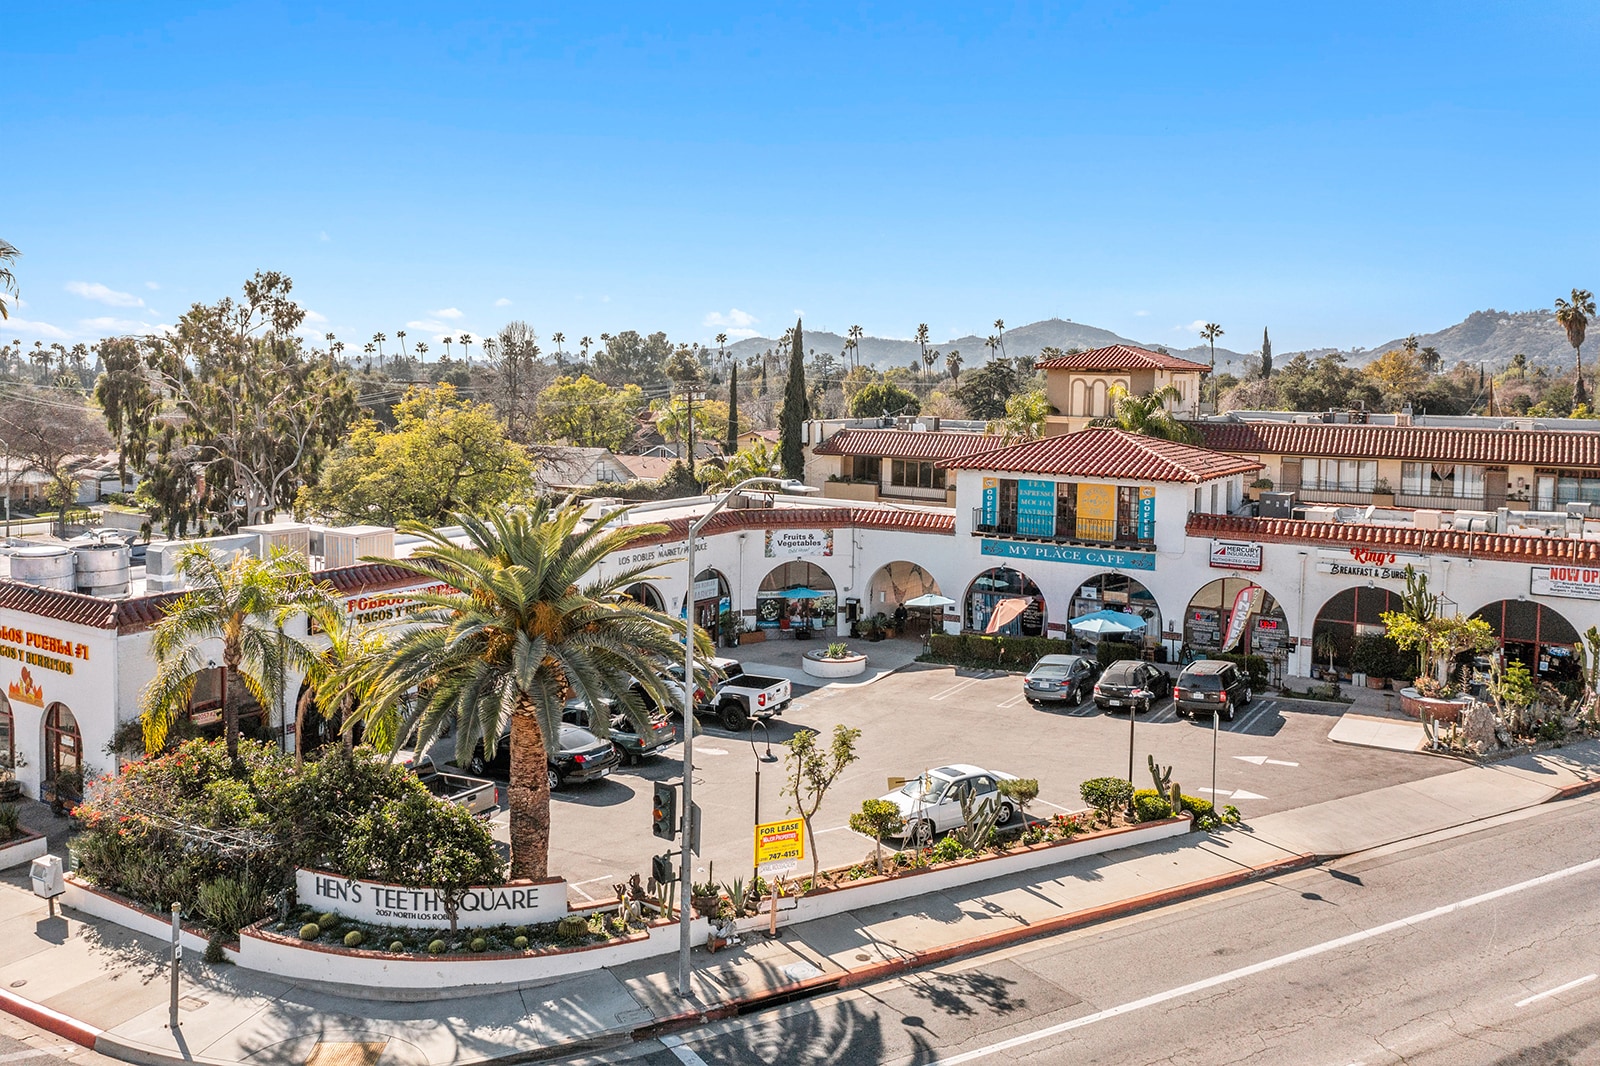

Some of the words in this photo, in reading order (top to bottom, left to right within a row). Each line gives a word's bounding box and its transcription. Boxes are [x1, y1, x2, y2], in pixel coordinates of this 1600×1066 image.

[1028, 480, 1046, 488] TEA
[1021, 499, 1052, 507] MOCHA
[618, 556, 631, 566] LOS
[632, 551, 655, 563] ROBLES
[1009, 545, 1032, 556] MY
[1086, 553, 1125, 565] CAFE
[1349, 547, 1397, 566] King's
[1374, 568, 1380, 577] &
[1380, 567, 1417, 580] BURGES
[1550, 567, 1580, 582] NOW
[1582, 569, 1600, 584] OP
[356, 607, 393, 626] TACOS
[395, 606, 404, 618] Y
[0, 625, 24, 645] LOS
[26, 631, 74, 657] PUEBLA
[75, 643, 90, 661] #1
[18, 649, 26, 662] Y
[26, 651, 74, 675] BURRITOS
[760, 827, 775, 835] FOR
[777, 822, 799, 832] LEASE
[768, 849, 799, 860] 747-4151
[316, 876, 362, 903] HEN'S
[370, 886, 438, 911] TEETH
[393, 911, 417, 920] NORTH
[417, 912, 431, 920] LOS
